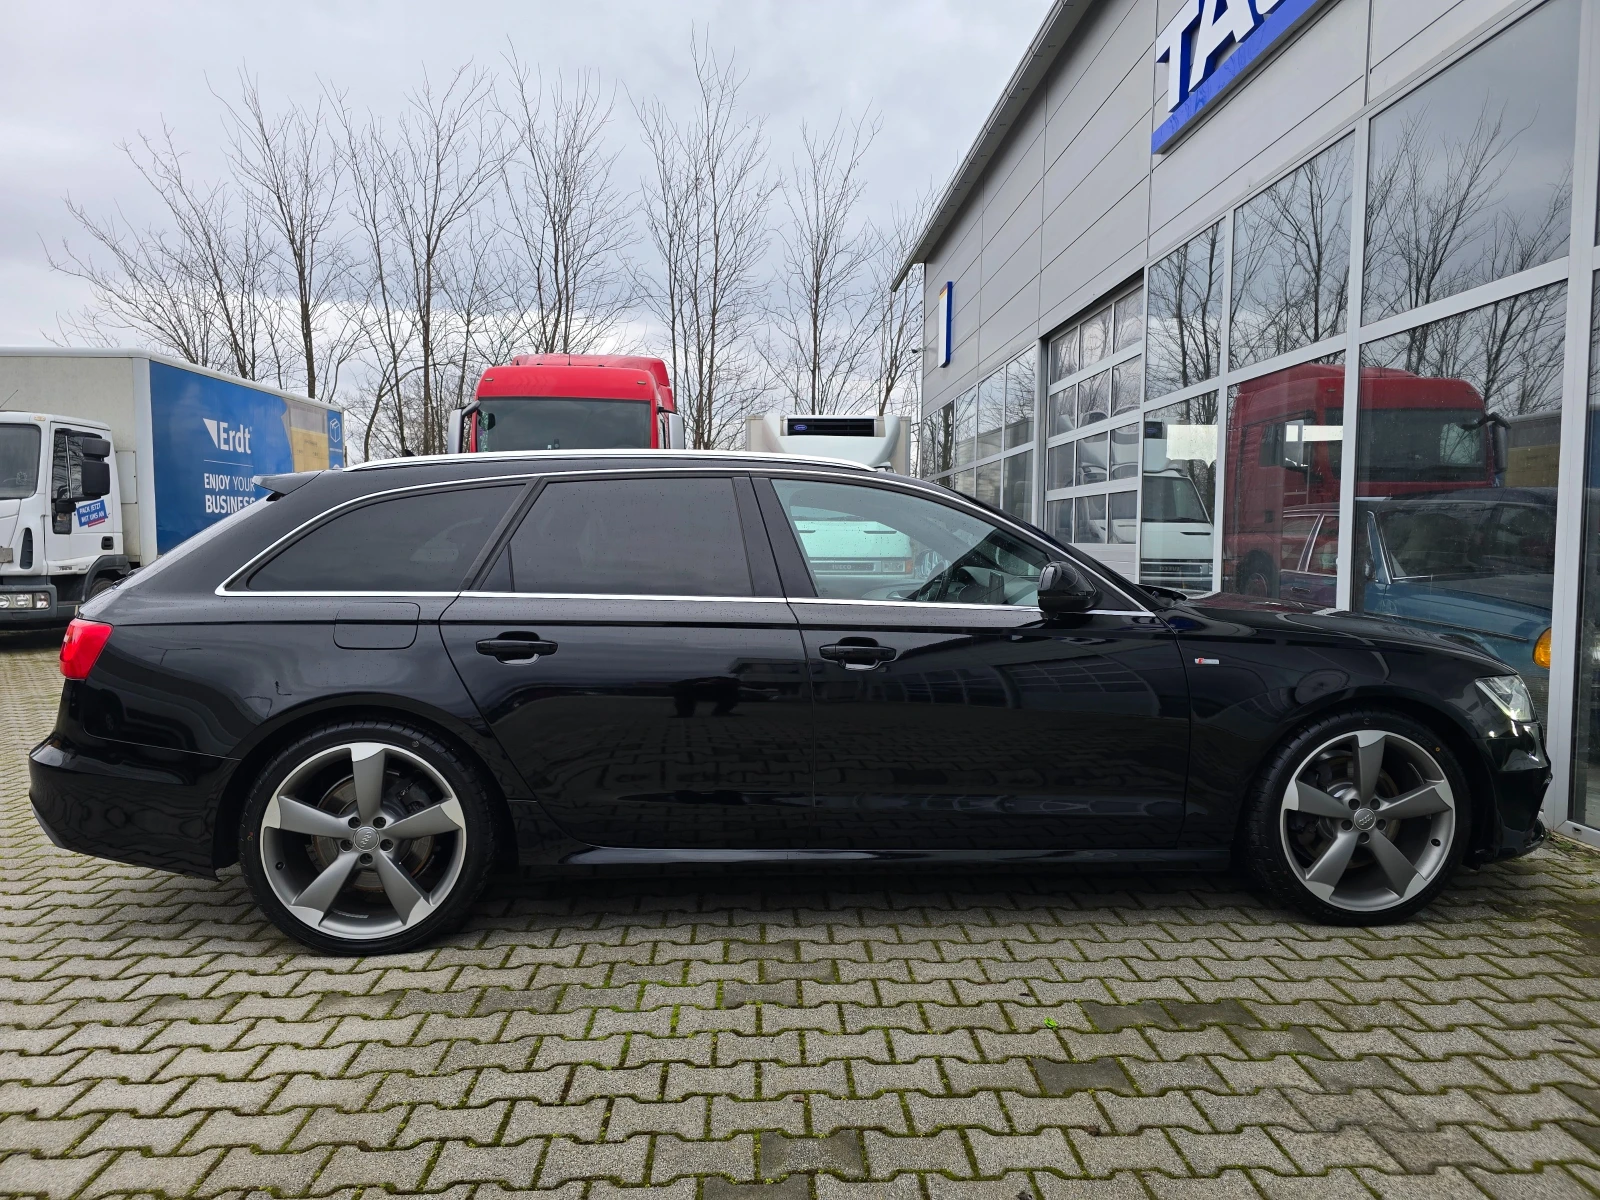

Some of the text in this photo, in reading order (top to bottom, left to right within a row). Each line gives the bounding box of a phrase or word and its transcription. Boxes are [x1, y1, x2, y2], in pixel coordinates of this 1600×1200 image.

[1156, 0, 1280, 112] TA
[220, 421, 252, 454] Erdt
[204, 473, 255, 492] ENJOY YOUR
